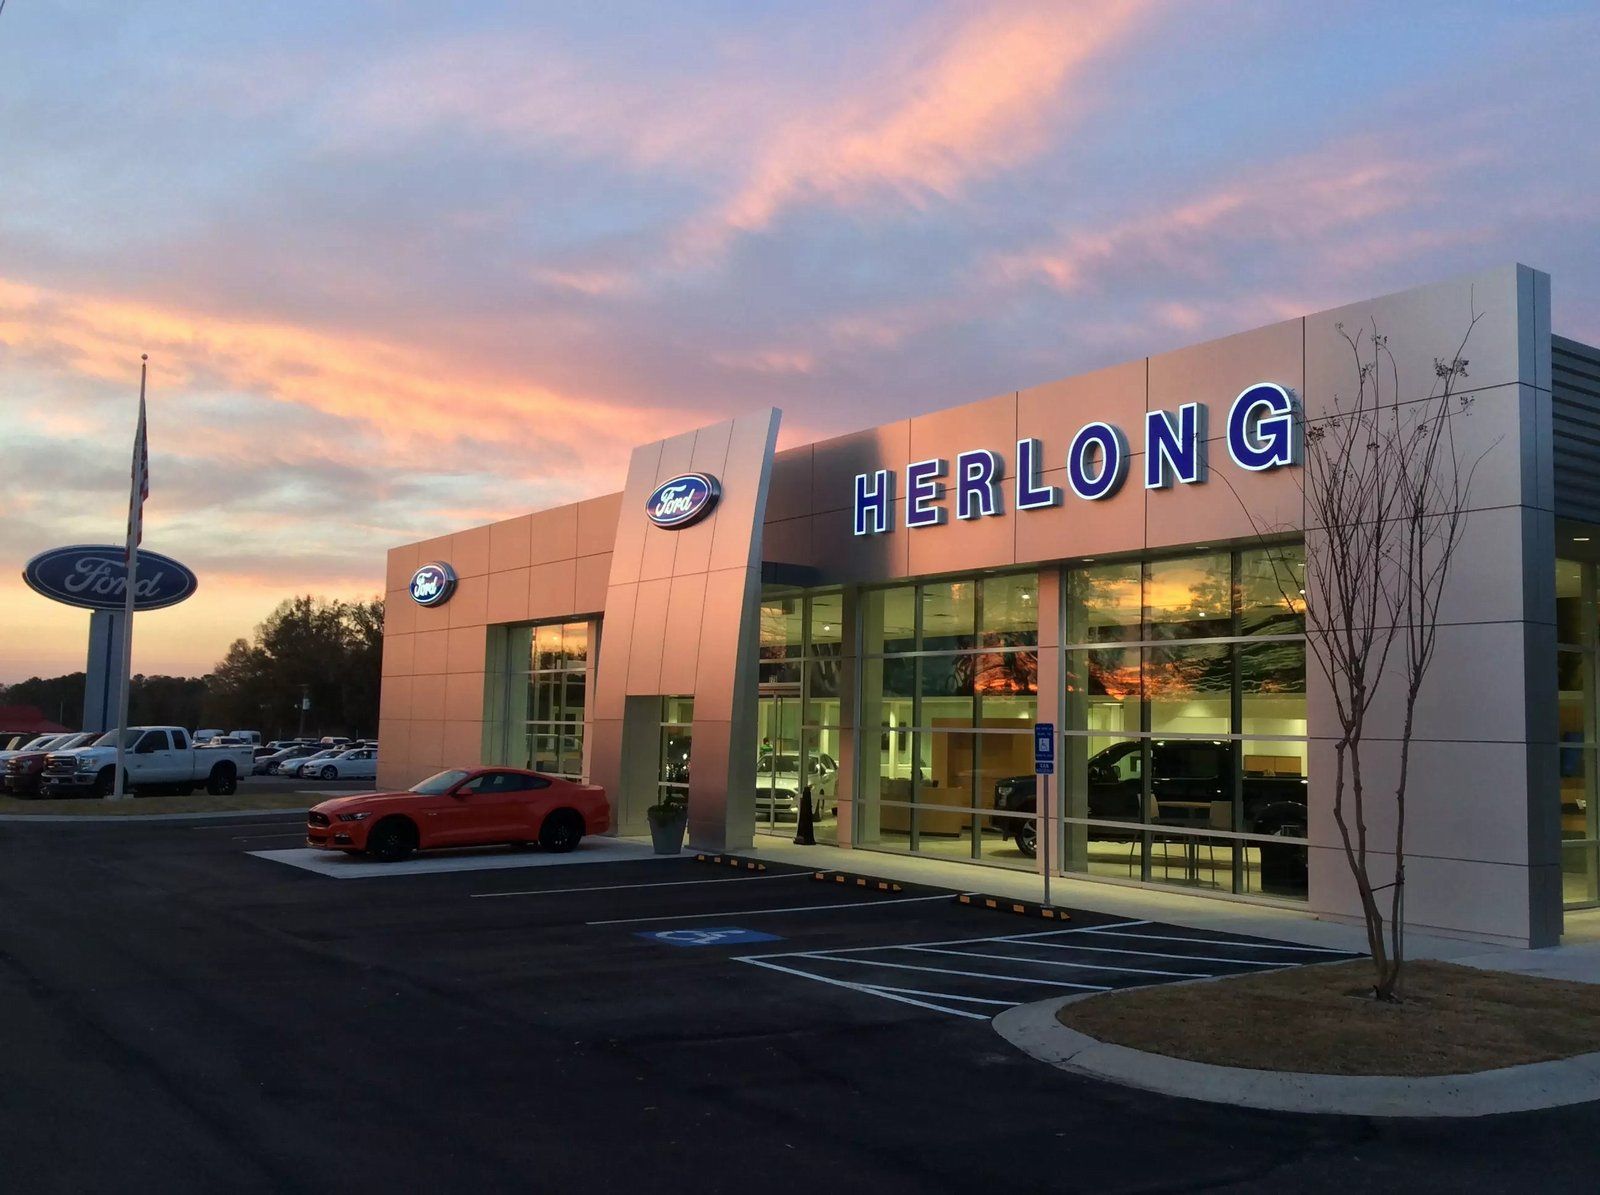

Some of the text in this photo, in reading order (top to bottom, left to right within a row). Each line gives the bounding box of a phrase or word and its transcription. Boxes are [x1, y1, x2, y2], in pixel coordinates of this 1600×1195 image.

[853, 381, 1297, 537] HERLONG
[654, 484, 696, 518] Ford
[64, 556, 164, 597] Ford
[413, 571, 438, 598] Ford
